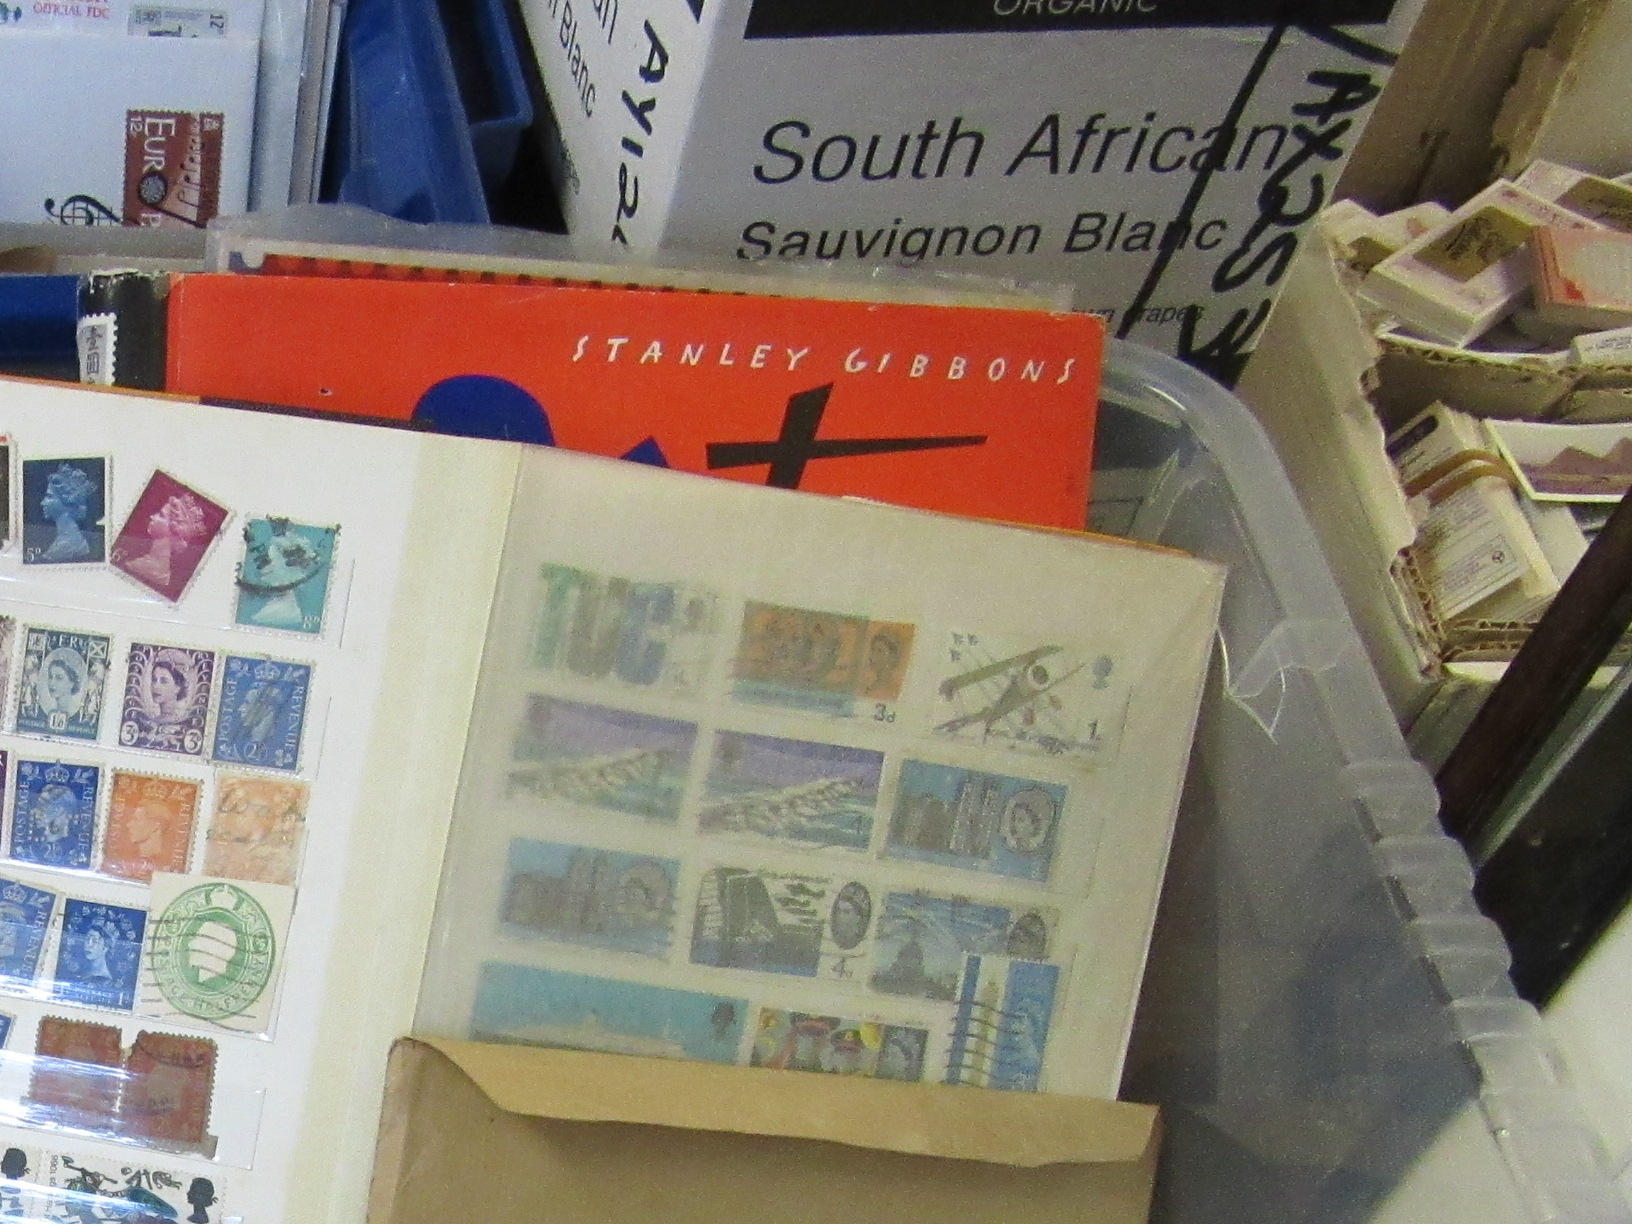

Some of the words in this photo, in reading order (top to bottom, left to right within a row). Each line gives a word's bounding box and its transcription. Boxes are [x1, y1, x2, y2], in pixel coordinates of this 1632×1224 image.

[32, 3, 82, 17] OFFICIAL
[86, 6, 110, 19] FDC
[753, 115, 986, 185] South
[1003, 111, 1290, 176] African
[736, 217, 1041, 268] Sauvignon
[1062, 212, 1229, 254] Blanc
[571, 335, 809, 372] STANLEY
[843, 346, 1076, 385] GIBBONS
[219, 677, 238, 746] POSTAGE
[283, 684, 305, 753] REVENUE
[13, 780, 30, 846] POSTAGE
[76, 786, 94, 858] REVENUE
[171, 802, 191, 868] REVENUE
